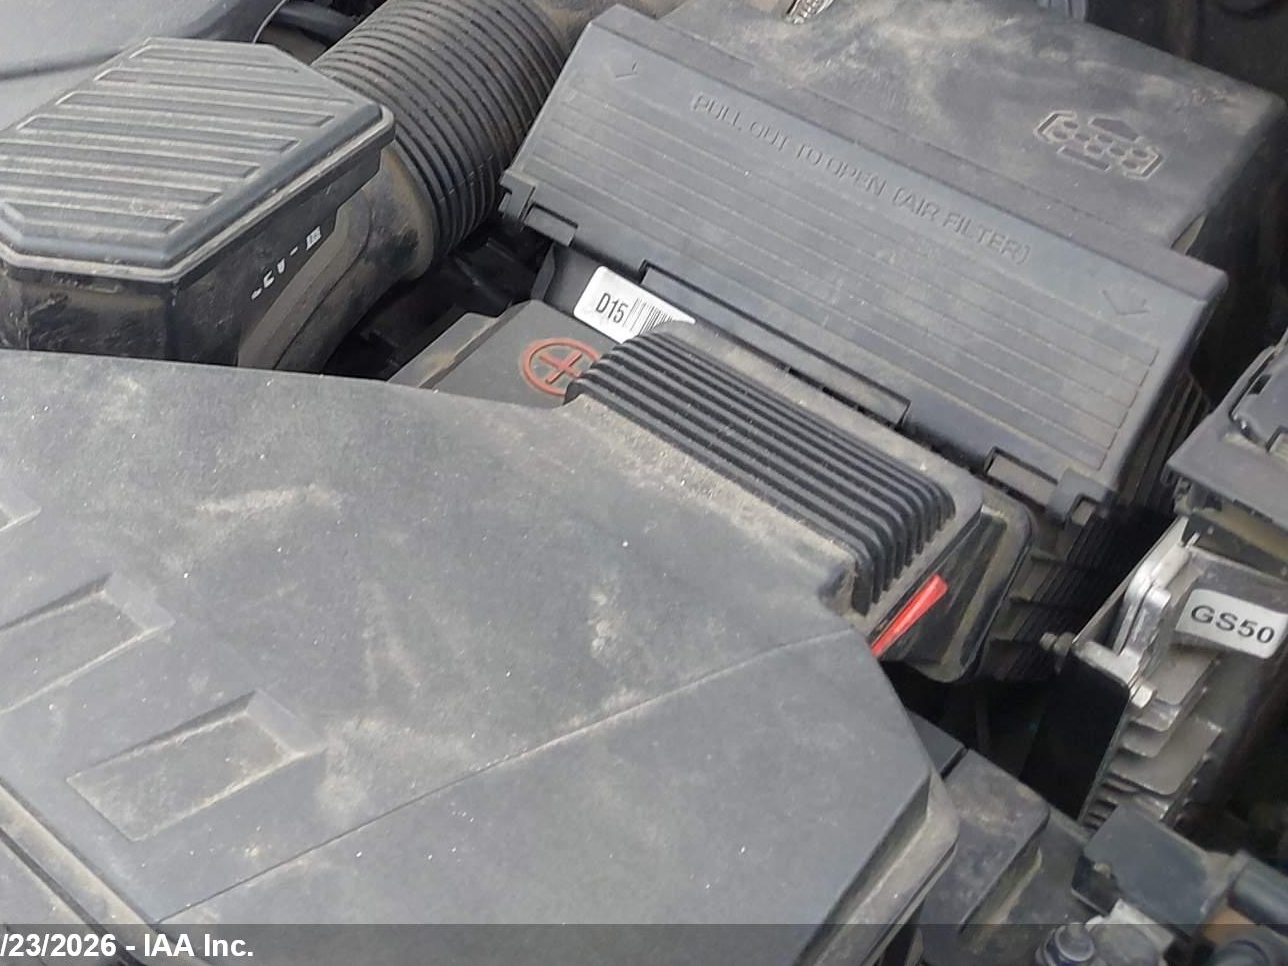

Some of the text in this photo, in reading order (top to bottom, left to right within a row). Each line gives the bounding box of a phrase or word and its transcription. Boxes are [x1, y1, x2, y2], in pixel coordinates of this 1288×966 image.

[689, 91, 1033, 266] PULL OUT TO OPEN (AIR FILTER)
[595, 291, 629, 324] D15
[1190, 604, 1276, 644] GS50
